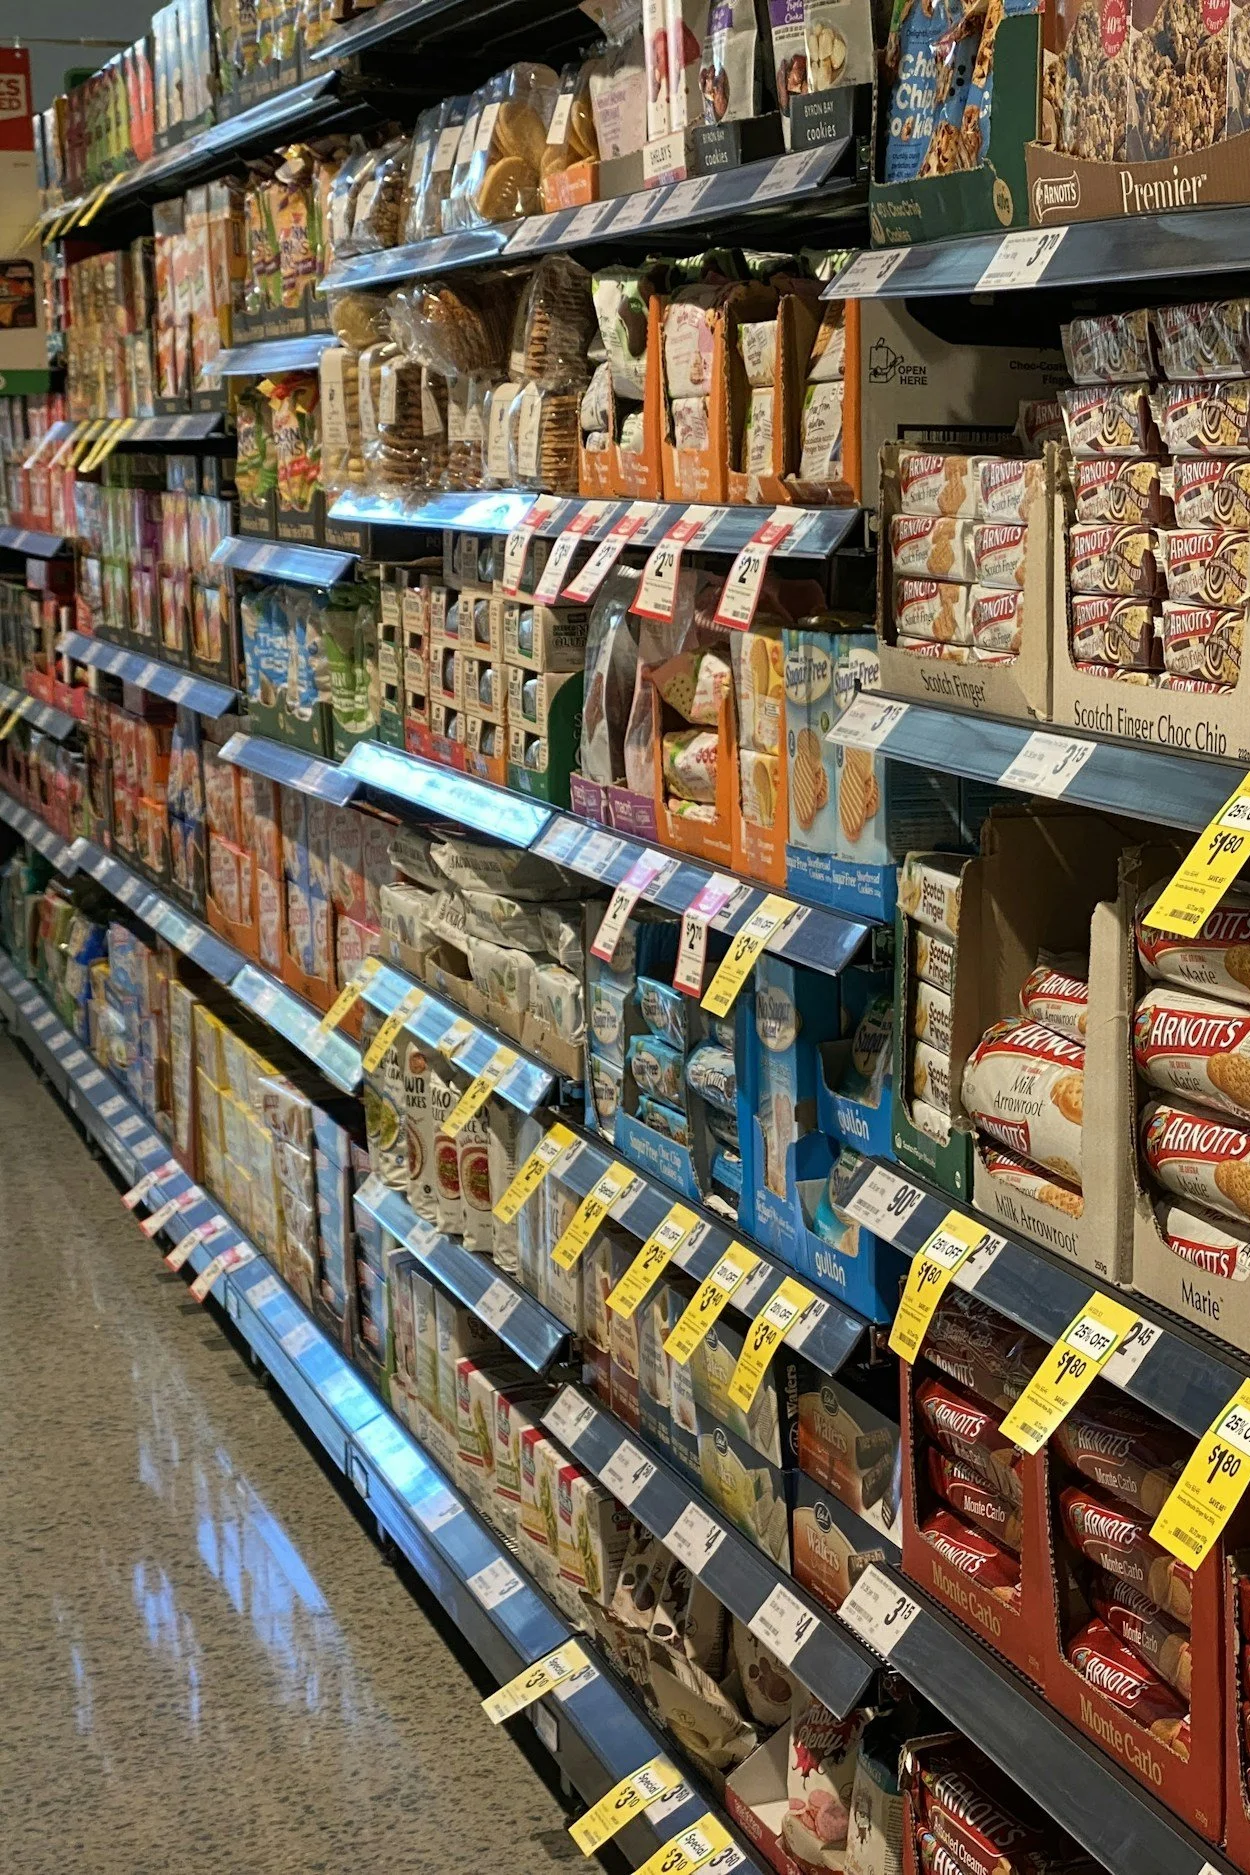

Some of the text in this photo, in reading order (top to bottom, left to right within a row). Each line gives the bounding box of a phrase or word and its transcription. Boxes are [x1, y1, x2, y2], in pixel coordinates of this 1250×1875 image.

[823, 101, 834, 114] BAY
[806, 122, 836, 141] cookies
[1043, 181, 1076, 204] ARNOTT'S
[1120, 166, 1202, 213] Premier
[898, 366, 926, 375] OPEN
[900, 376, 927, 385] HERE
[1170, 534, 1214, 561] ARNOTT'S
[921, 669, 984, 708] Scotch Finger
[1074, 699, 1227, 755] Scotch Finger Choc Chip
[922, 876, 945, 898] Scotch
[922, 897, 944, 920] Finger
[1178, 963, 1217, 986] Marie
[1151, 1012, 1244, 1048] ARNOTT'S
[1010, 1074, 1035, 1095] Milk
[993, 1090, 1043, 1116] Arrowroot
[995, 1195, 1077, 1256] Milk Arrowroot
[1181, 1277, 1221, 1321] Marie
[963, 1495, 1006, 1524] Monte Carlo
[1084, 1509, 1142, 1545] ARNOTT'S
[806, 1527, 840, 1571] Wafers
[931, 1560, 1001, 1637] Monte Carlo
[684, 1833, 708, 1856] Special
